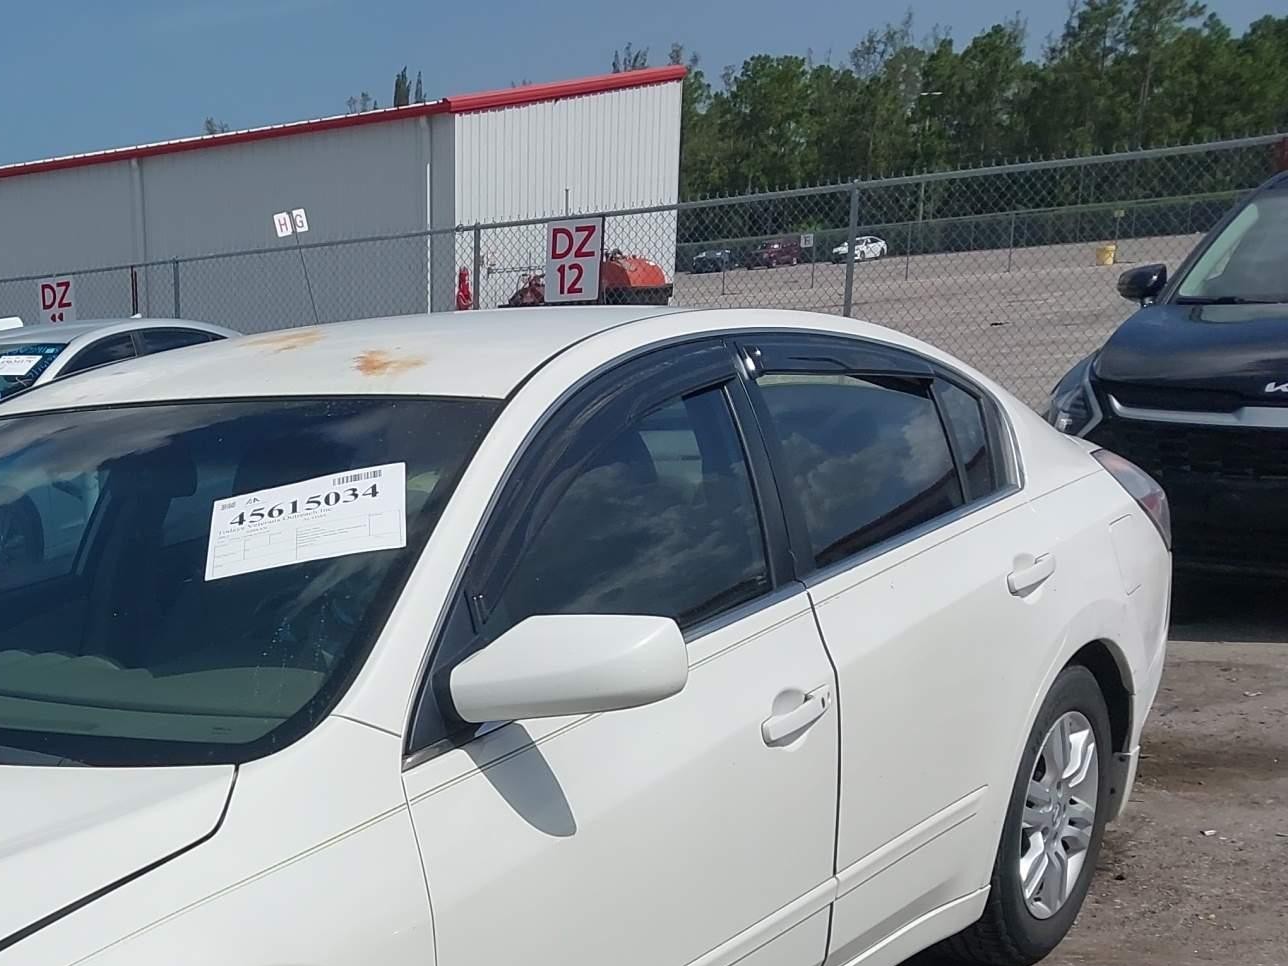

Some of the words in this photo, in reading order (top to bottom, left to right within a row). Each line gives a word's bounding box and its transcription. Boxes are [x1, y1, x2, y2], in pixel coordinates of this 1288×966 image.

[278, 216, 289, 233] H
[295, 214, 305, 229] G
[551, 225, 596, 260] DZ
[41, 280, 72, 310] DZ
[557, 262, 584, 295] 12
[229, 483, 380, 526] 45615034
